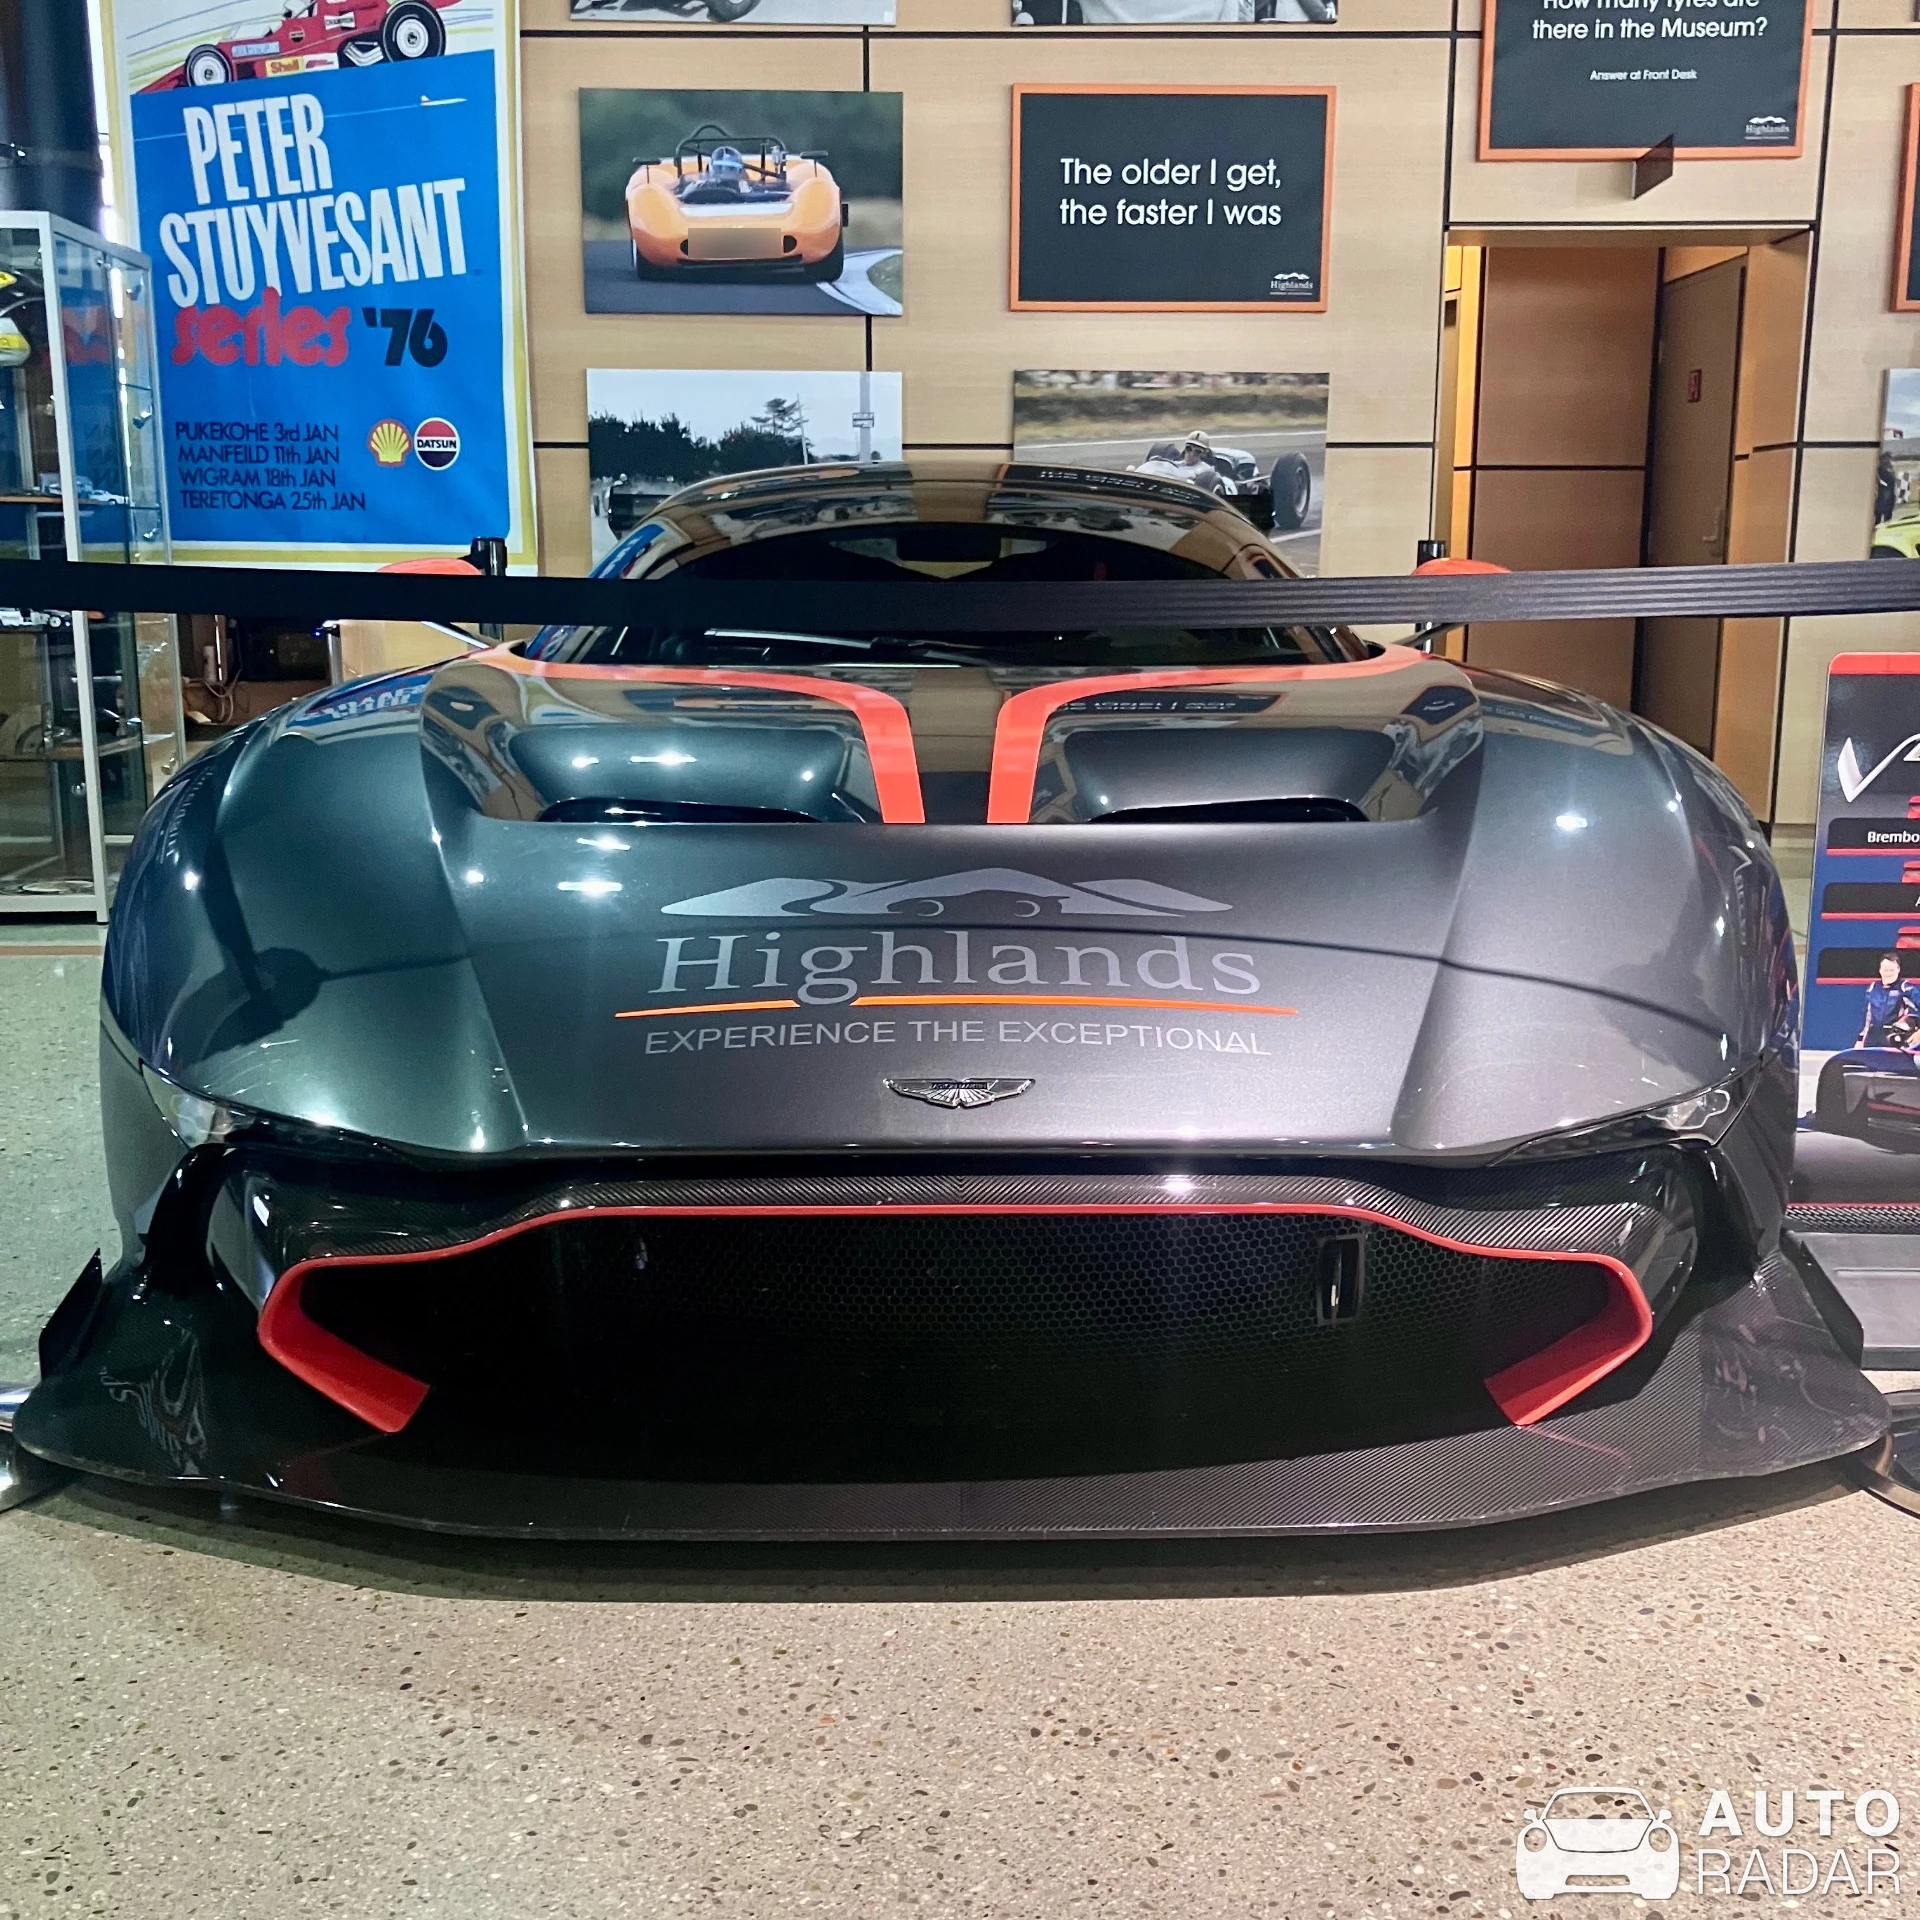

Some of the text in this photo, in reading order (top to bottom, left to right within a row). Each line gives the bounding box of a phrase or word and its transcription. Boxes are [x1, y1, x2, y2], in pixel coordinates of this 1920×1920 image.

[1532, 16, 1768, 39] there in the Museum?
[1589, 69, 1698, 81] Answer at Front Desk
[183, 93, 333, 205] PETER
[1060, 157, 1281, 192] The older I get,
[1059, 198, 1282, 226] the faster I was
[159, 178, 467, 308] STUYVESANT
[172, 286, 449, 368] series '76
[174, 421, 339, 443] PUKEKOHE 3rd JAN
[274, 445, 301, 465] 11th
[304, 445, 340, 465] JAN
[416, 439, 457, 449] DATSUN
[178, 467, 336, 488] WIGRAM 18th JAN
[179, 489, 366, 511] TERETONGA 25th JAN
[1867, 830, 1919, 843] Brembo
[647, 931, 1261, 1005] Highlands
[645, 1020, 1272, 1056] EXPERIENCE THE EXCEPTIONAL
